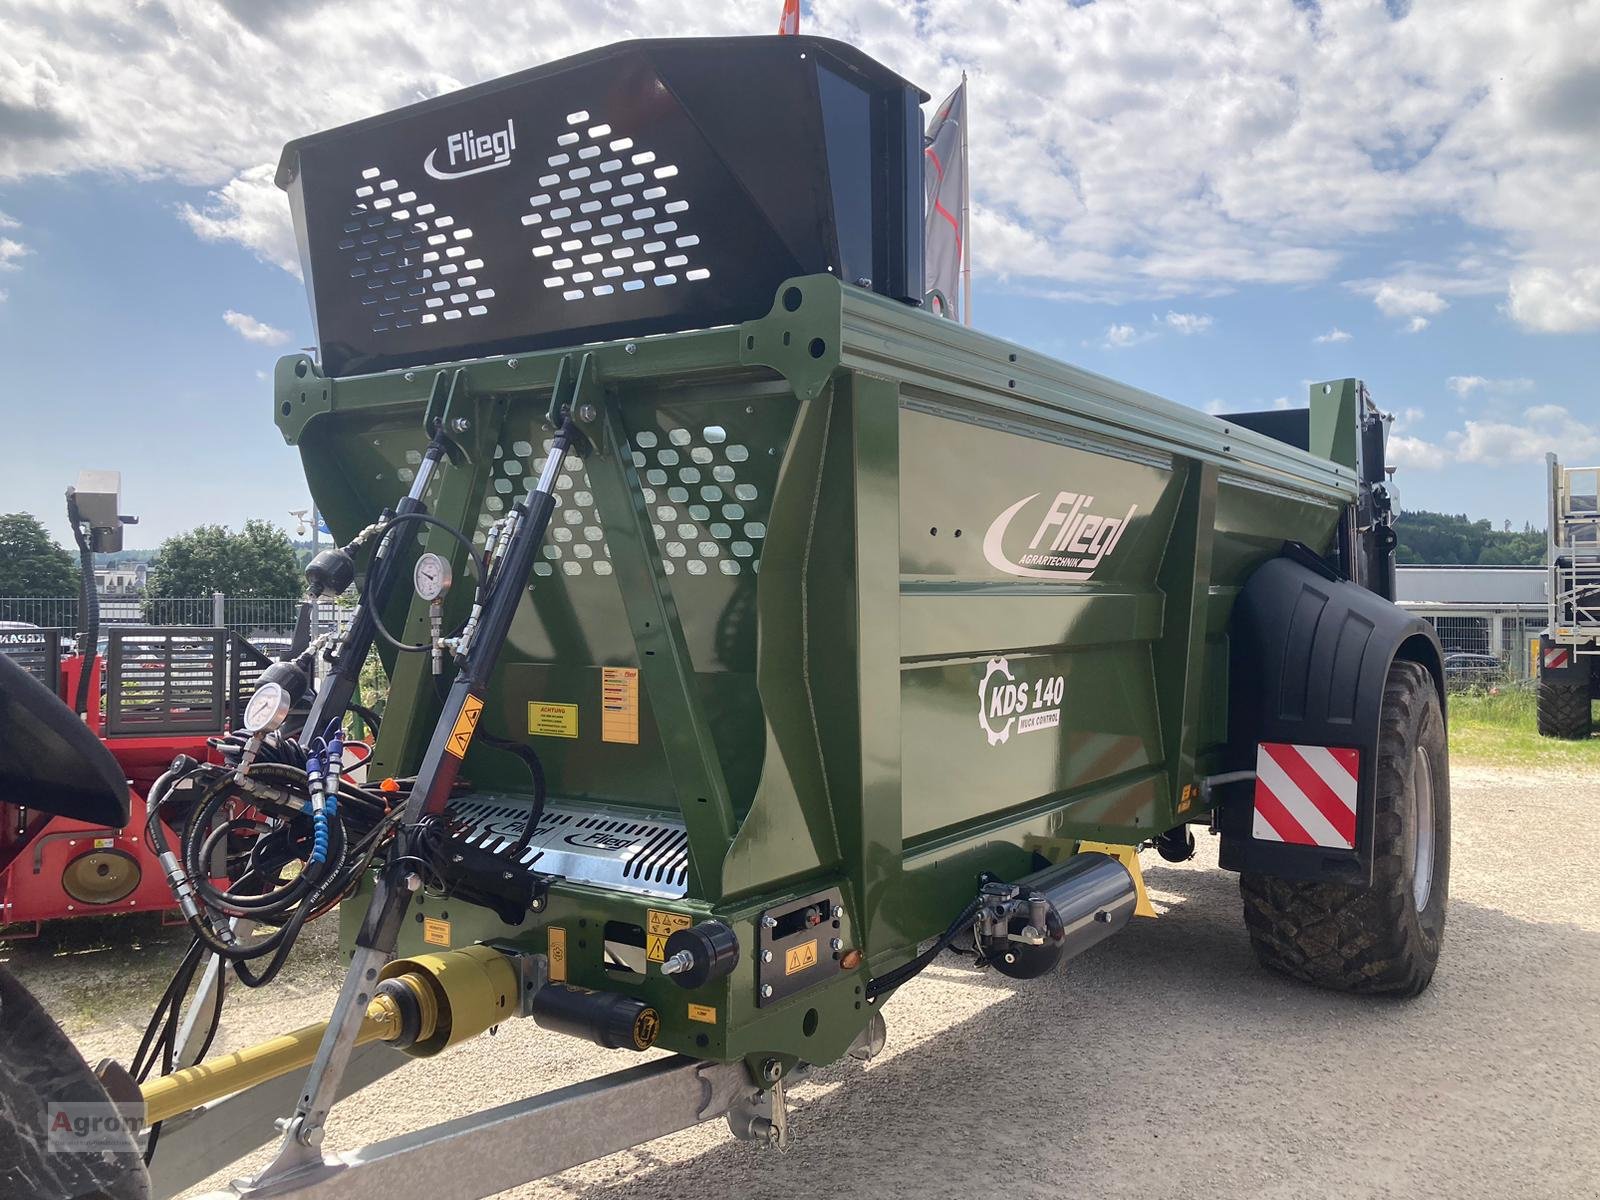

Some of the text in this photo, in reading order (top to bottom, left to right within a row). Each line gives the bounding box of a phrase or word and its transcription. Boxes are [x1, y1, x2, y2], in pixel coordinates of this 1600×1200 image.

[447, 118, 516, 166] Fliegl
[1028, 491, 1138, 569] Fliegl
[1018, 554, 1081, 568] AGRARTECHNIK
[989, 675, 1065, 719] KDS 140
[540, 706, 566, 714] ACHTUNG
[1020, 712, 1059, 730] MUCK CONTROL
[502, 821, 556, 837] Fligl
[583, 832, 641, 850] Fliegl
